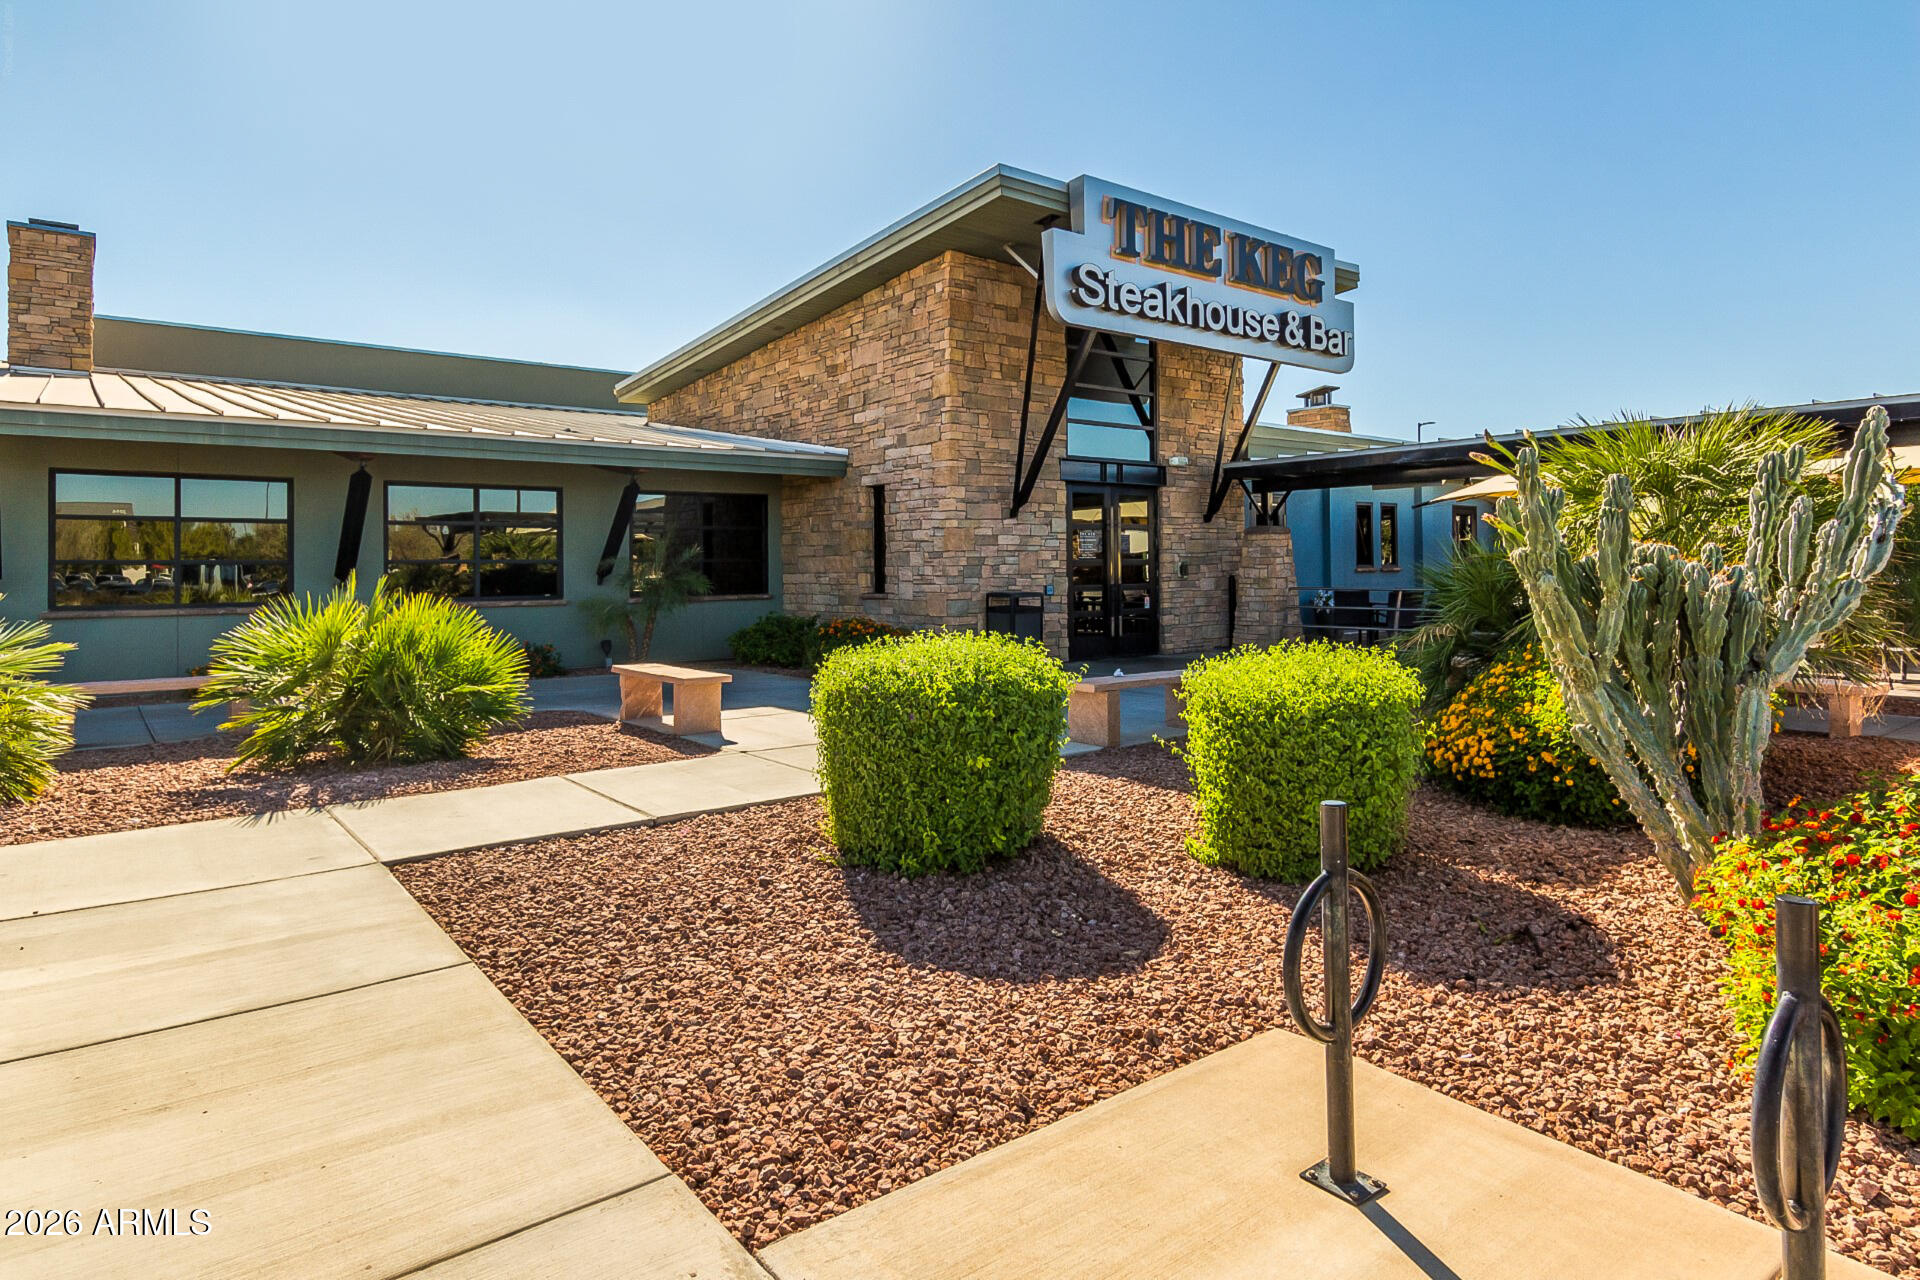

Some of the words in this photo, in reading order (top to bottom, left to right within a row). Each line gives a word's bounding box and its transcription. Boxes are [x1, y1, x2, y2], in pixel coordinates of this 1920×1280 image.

[1102, 195, 1222, 281] THE
[1224, 230, 1325, 305] KEG
[1074, 263, 1280, 341] Steakhouse
[1284, 310, 1305, 348] &
[1309, 315, 1353, 356] Bar
